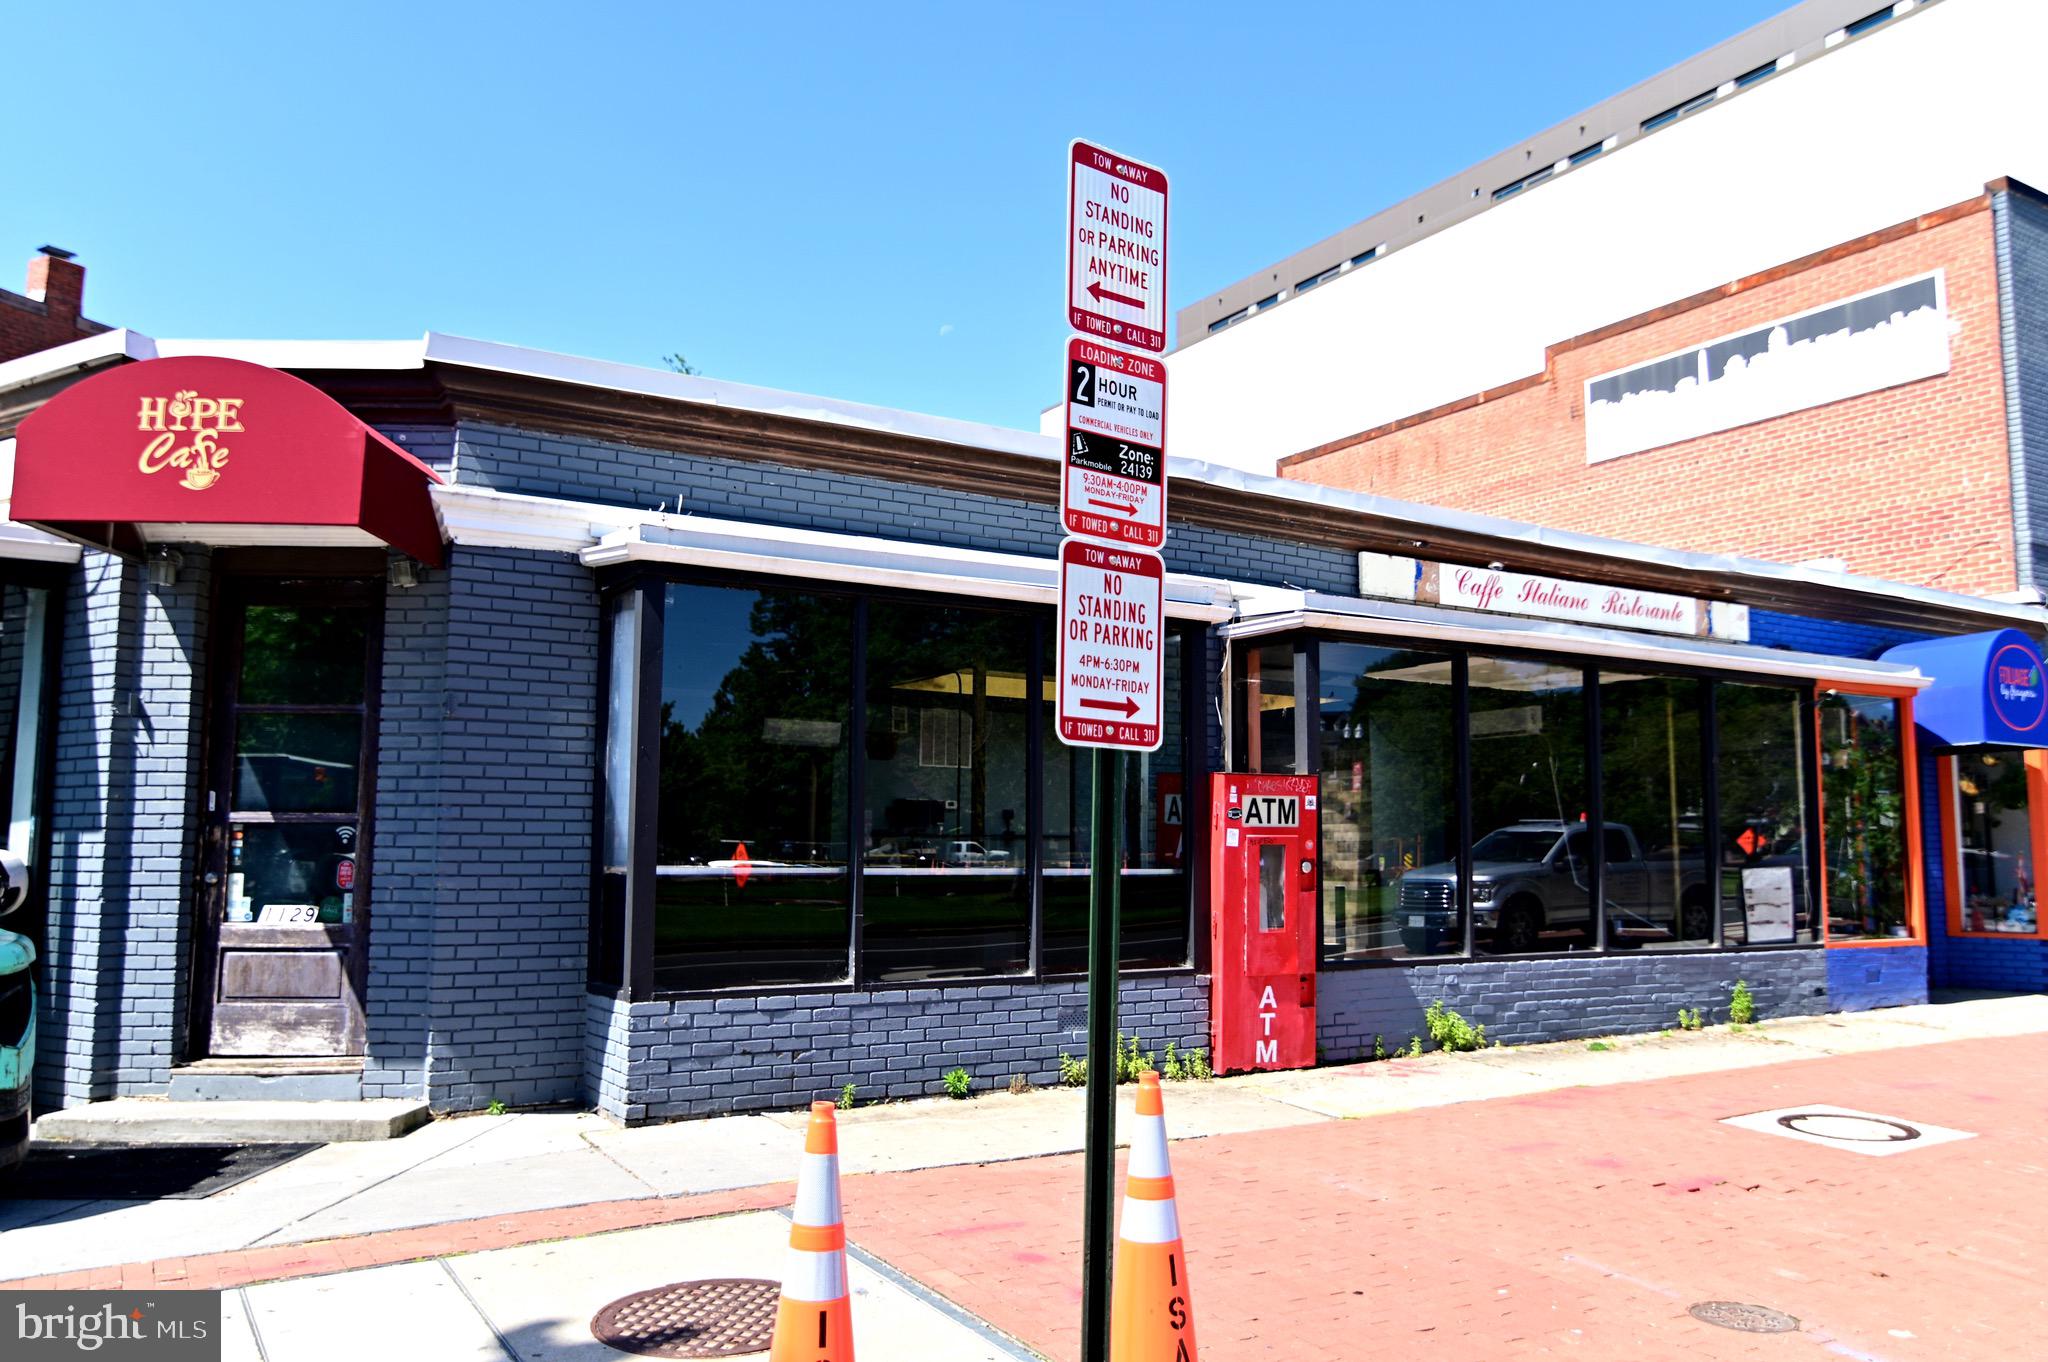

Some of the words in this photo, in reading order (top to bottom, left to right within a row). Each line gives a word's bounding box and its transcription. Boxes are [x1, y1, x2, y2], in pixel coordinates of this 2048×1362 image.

[1093, 152, 1112, 170] TOW
[1123, 165, 1148, 183] AWAY
[1111, 182, 1129, 204] NO
[1085, 200, 1153, 239] STANDING
[1079, 228, 1095, 246] OR
[1099, 231, 1159, 267] PARKING
[1089, 256, 1148, 290] ANYTIME
[1074, 312, 1082, 325] IF
[1086, 316, 1111, 335] TOWED
[1126, 327, 1146, 345] CALL
[1150, 334, 1161, 349] 311
[1080, 344, 1124, 369] LOADING
[1128, 358, 1155, 378] ZONE
[1076, 366, 1089, 402] 2
[1098, 377, 1137, 401] HOUR
[1097, 397, 1116, 411] PERMIT
[1117, 403, 1125, 412] OR
[1126, 404, 1137, 415] PAY
[1137, 407, 1145, 417] TO
[1145, 409, 1160, 421] LOAD
[1078, 415, 1113, 431] COMMERCIAL
[1113, 423, 1138, 438] VEHICLES
[1139, 428, 1153, 441] ONLY
[138, 429, 230, 475] Cafe
[1070, 455, 1112, 472] Parkmobile
[1119, 444, 1154, 465] Zone:
[1120, 460, 1153, 479] 24139
[1083, 472, 1148, 497] 9:30AM-4:00PM
[1084, 485, 1145, 504] MONDAY-FRIDAY
[1069, 513, 1078, 527] IF
[1081, 516, 1108, 534] TOWED
[1123, 524, 1144, 542] CALL
[1147, 529, 1159, 543] 311
[1085, 548, 1105, 564] TOW
[1116, 554, 1142, 571] AWAY
[1104, 573, 1122, 595] NO
[1455, 568, 1504, 609] Caffe
[1517, 578, 1589, 611] Italiano
[1601, 591, 1684, 623] Ristorante
[1078, 594, 1146, 625] STANDING
[1069, 619, 1088, 642] OR
[1094, 623, 1153, 651] PARKING
[1079, 654, 1140, 674] 4PM-6:30PM
[1071, 673, 1150, 695] MONDAY-FRIDAY
[1064, 721, 1073, 735] IF
[1077, 722, 1103, 737] TOWED
[1119, 726, 1140, 742] CALL
[1143, 729, 1155, 742] 311
[1245, 797, 1296, 825] ATM
[265, 907, 315, 923] 1129
[1255, 985, 1278, 1064] ATM
